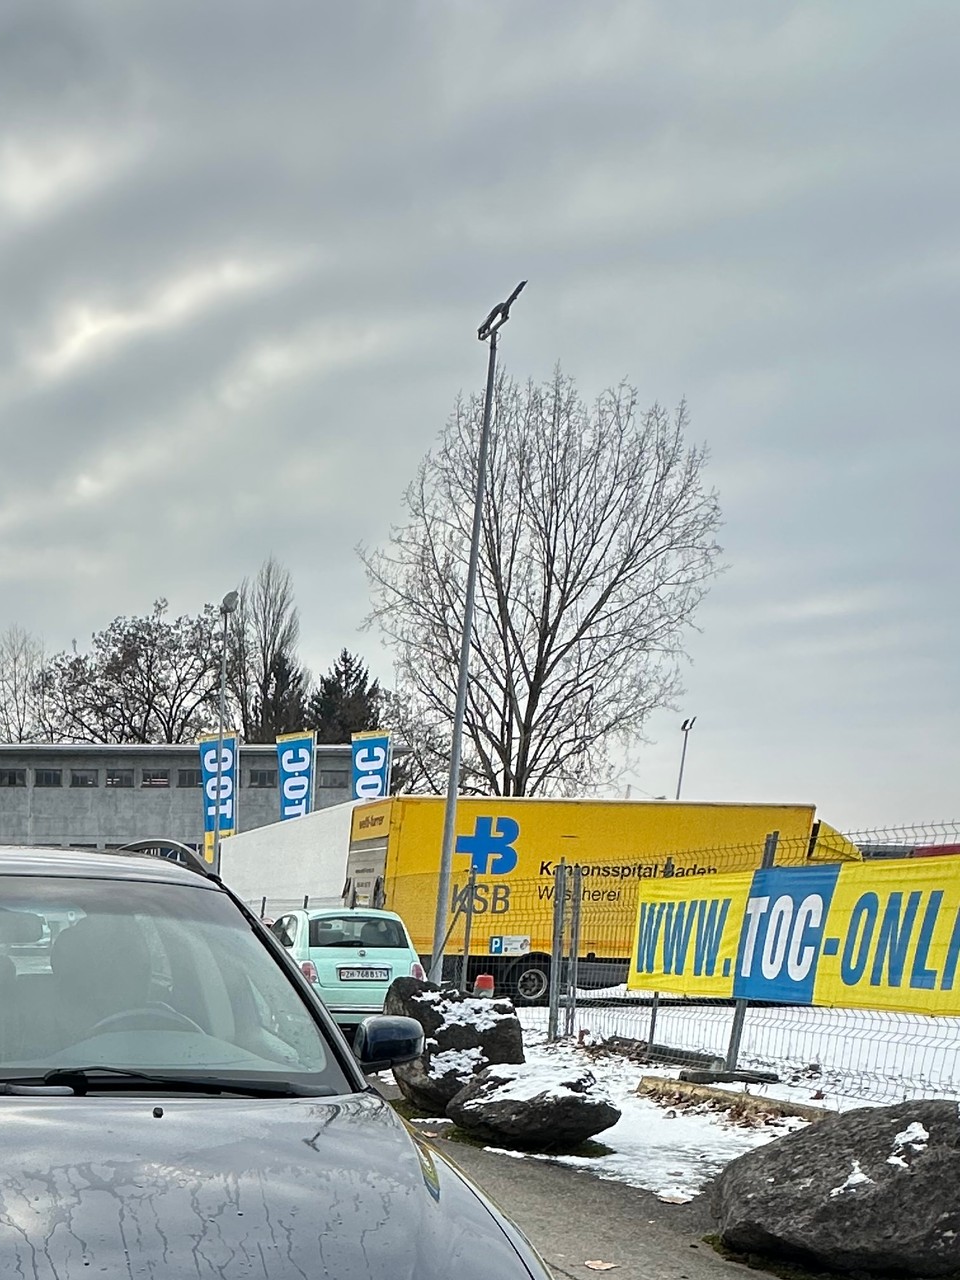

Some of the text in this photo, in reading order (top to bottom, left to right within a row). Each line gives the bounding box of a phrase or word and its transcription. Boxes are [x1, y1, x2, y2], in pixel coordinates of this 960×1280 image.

[539, 860, 658, 880] Knonsspital
[451, 884, 510, 914] KSB
[538, 885, 621, 901] Wsherei
